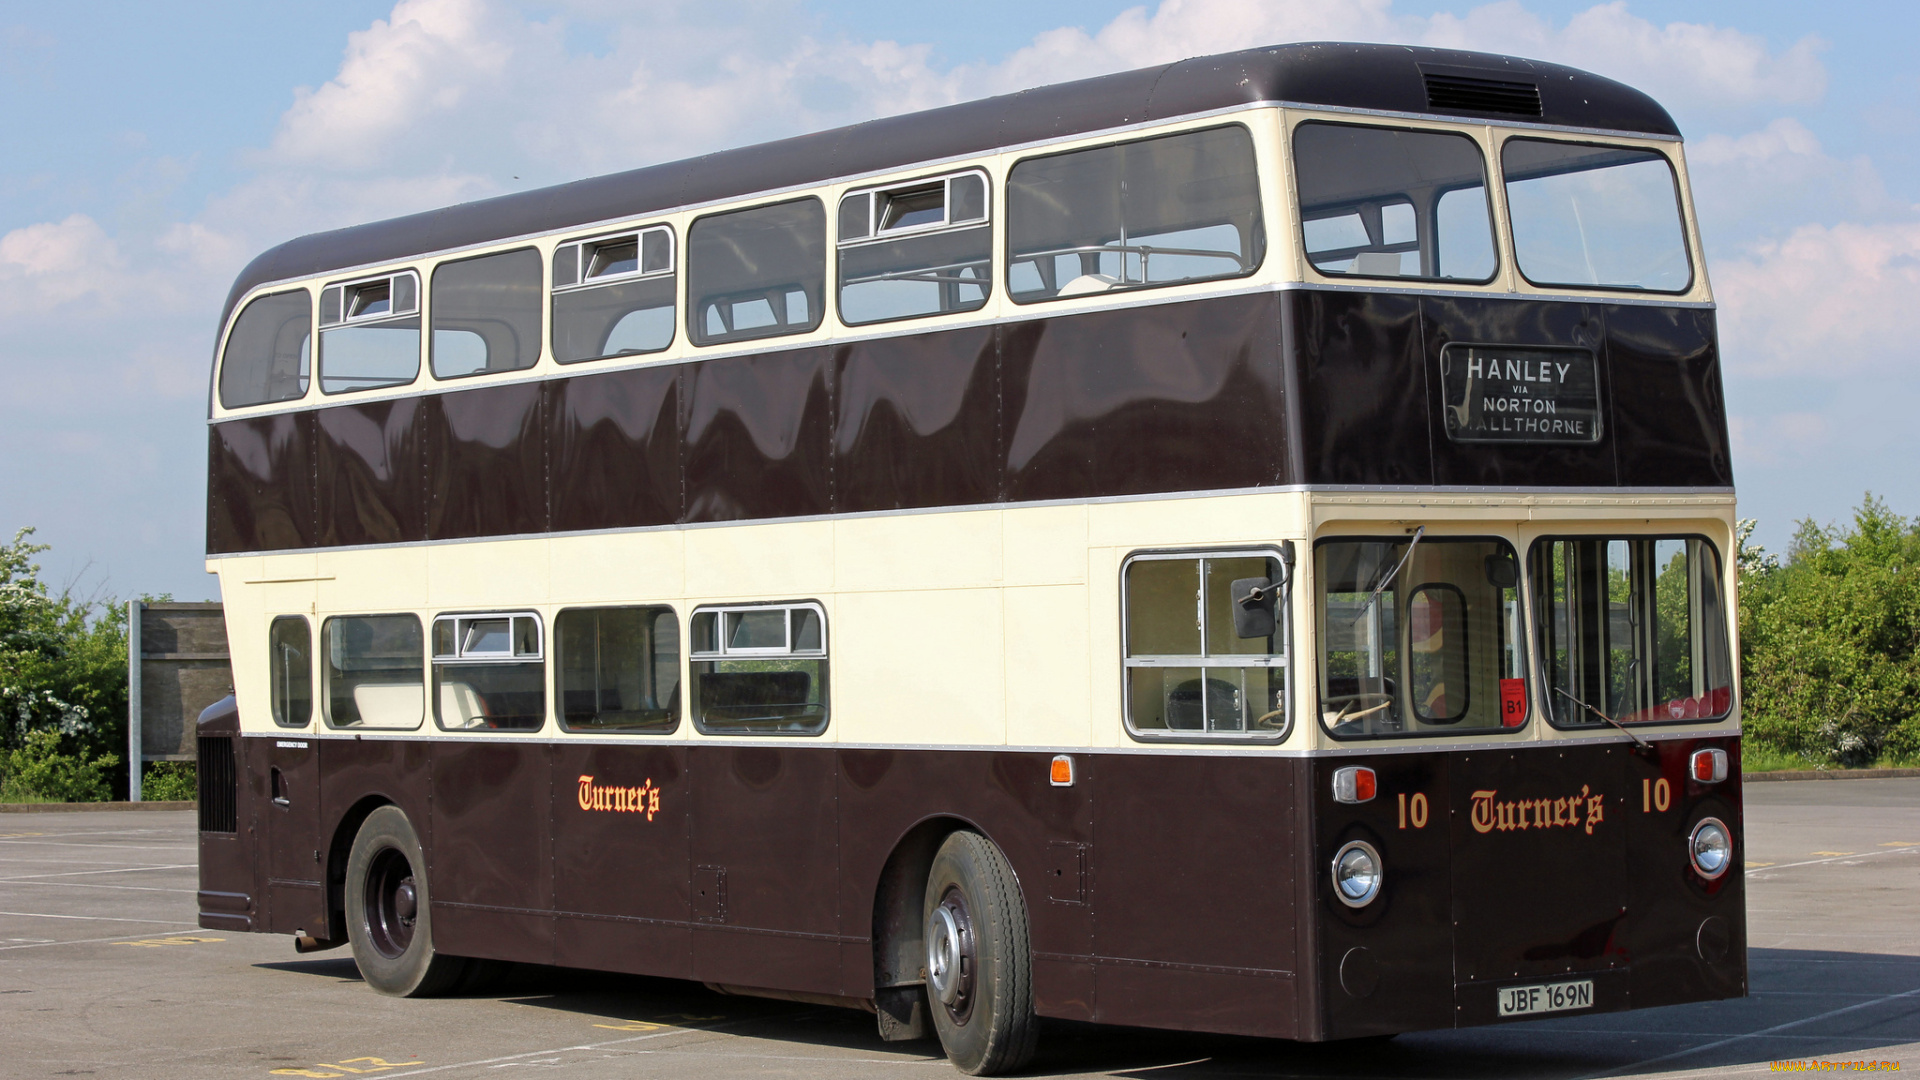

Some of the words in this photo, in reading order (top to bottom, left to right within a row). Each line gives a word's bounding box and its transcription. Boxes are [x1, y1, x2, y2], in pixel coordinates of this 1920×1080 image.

[1467, 357, 1571, 384] HANLEY
[1512, 385, 1528, 394] VIA
[1483, 397, 1556, 414] NORTON
[1507, 700, 1522, 714] B1
[577, 774, 660, 822] Turner's
[1398, 792, 1429, 829] 10
[1470, 784, 1605, 835] Turner's
[1642, 777, 1671, 813] 10
[1503, 987, 1541, 1013] JBF
[1546, 982, 1590, 1009] 169N
